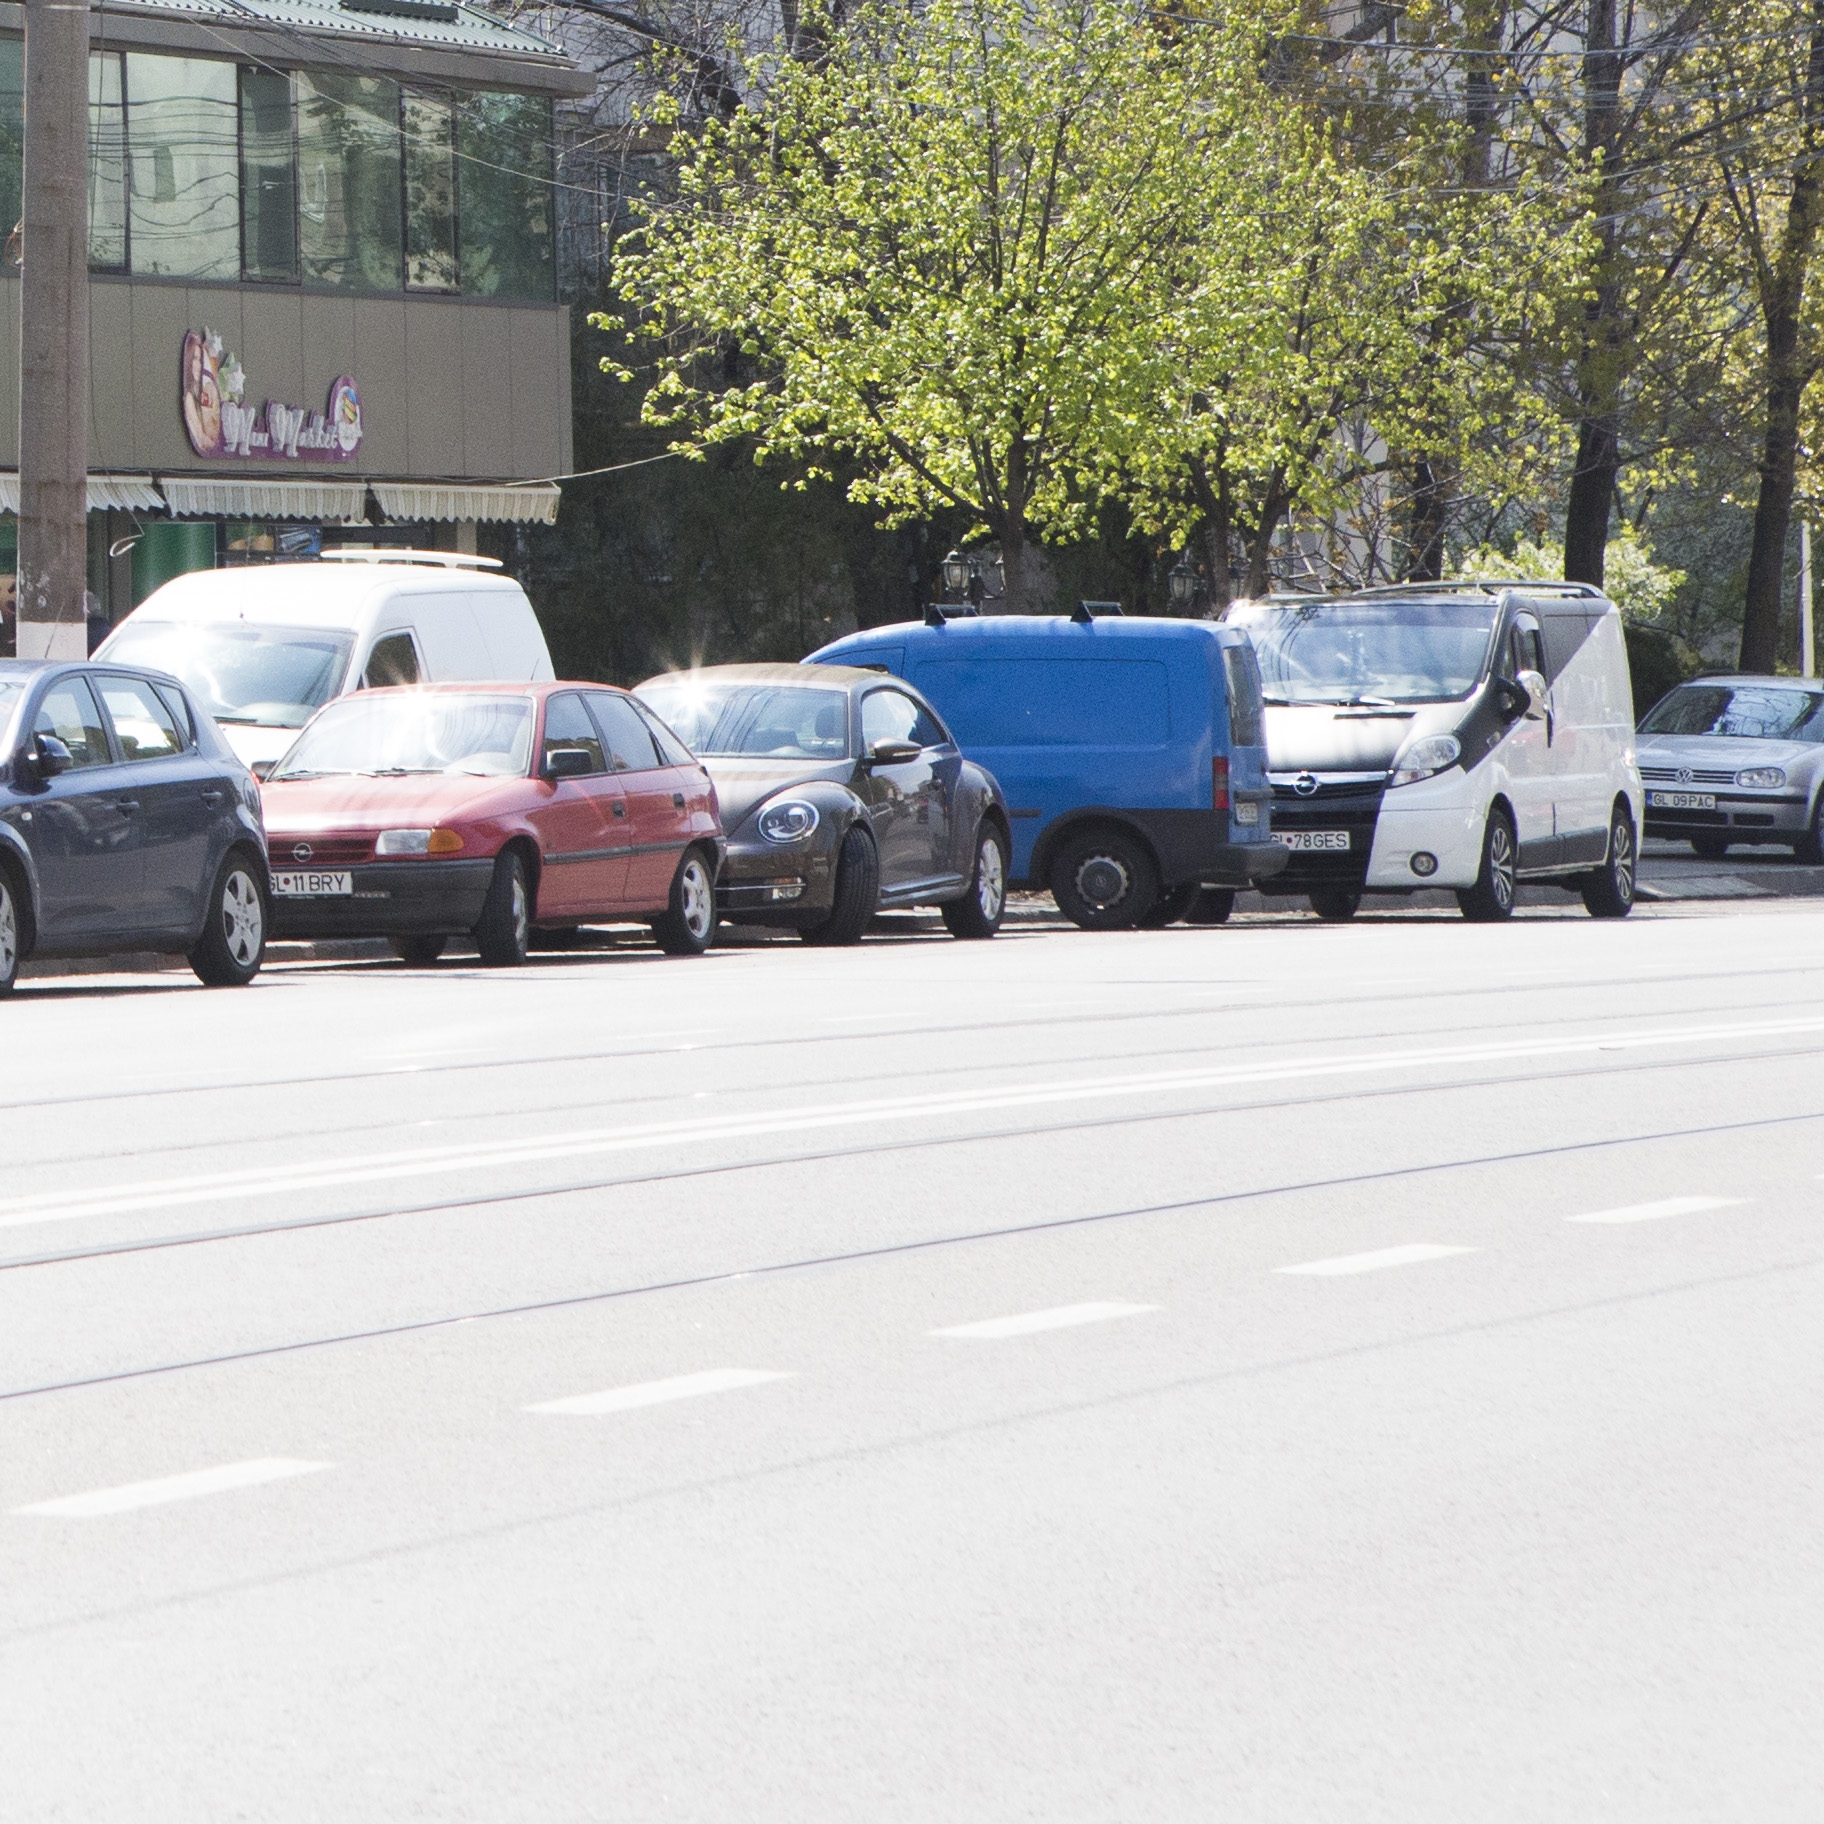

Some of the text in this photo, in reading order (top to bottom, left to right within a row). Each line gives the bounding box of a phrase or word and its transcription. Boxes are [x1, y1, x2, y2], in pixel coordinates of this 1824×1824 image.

[1653, 793, 1669, 807] GL
[1294, 833, 1347, 848] 78GES
[309, 874, 346, 892] BRY
